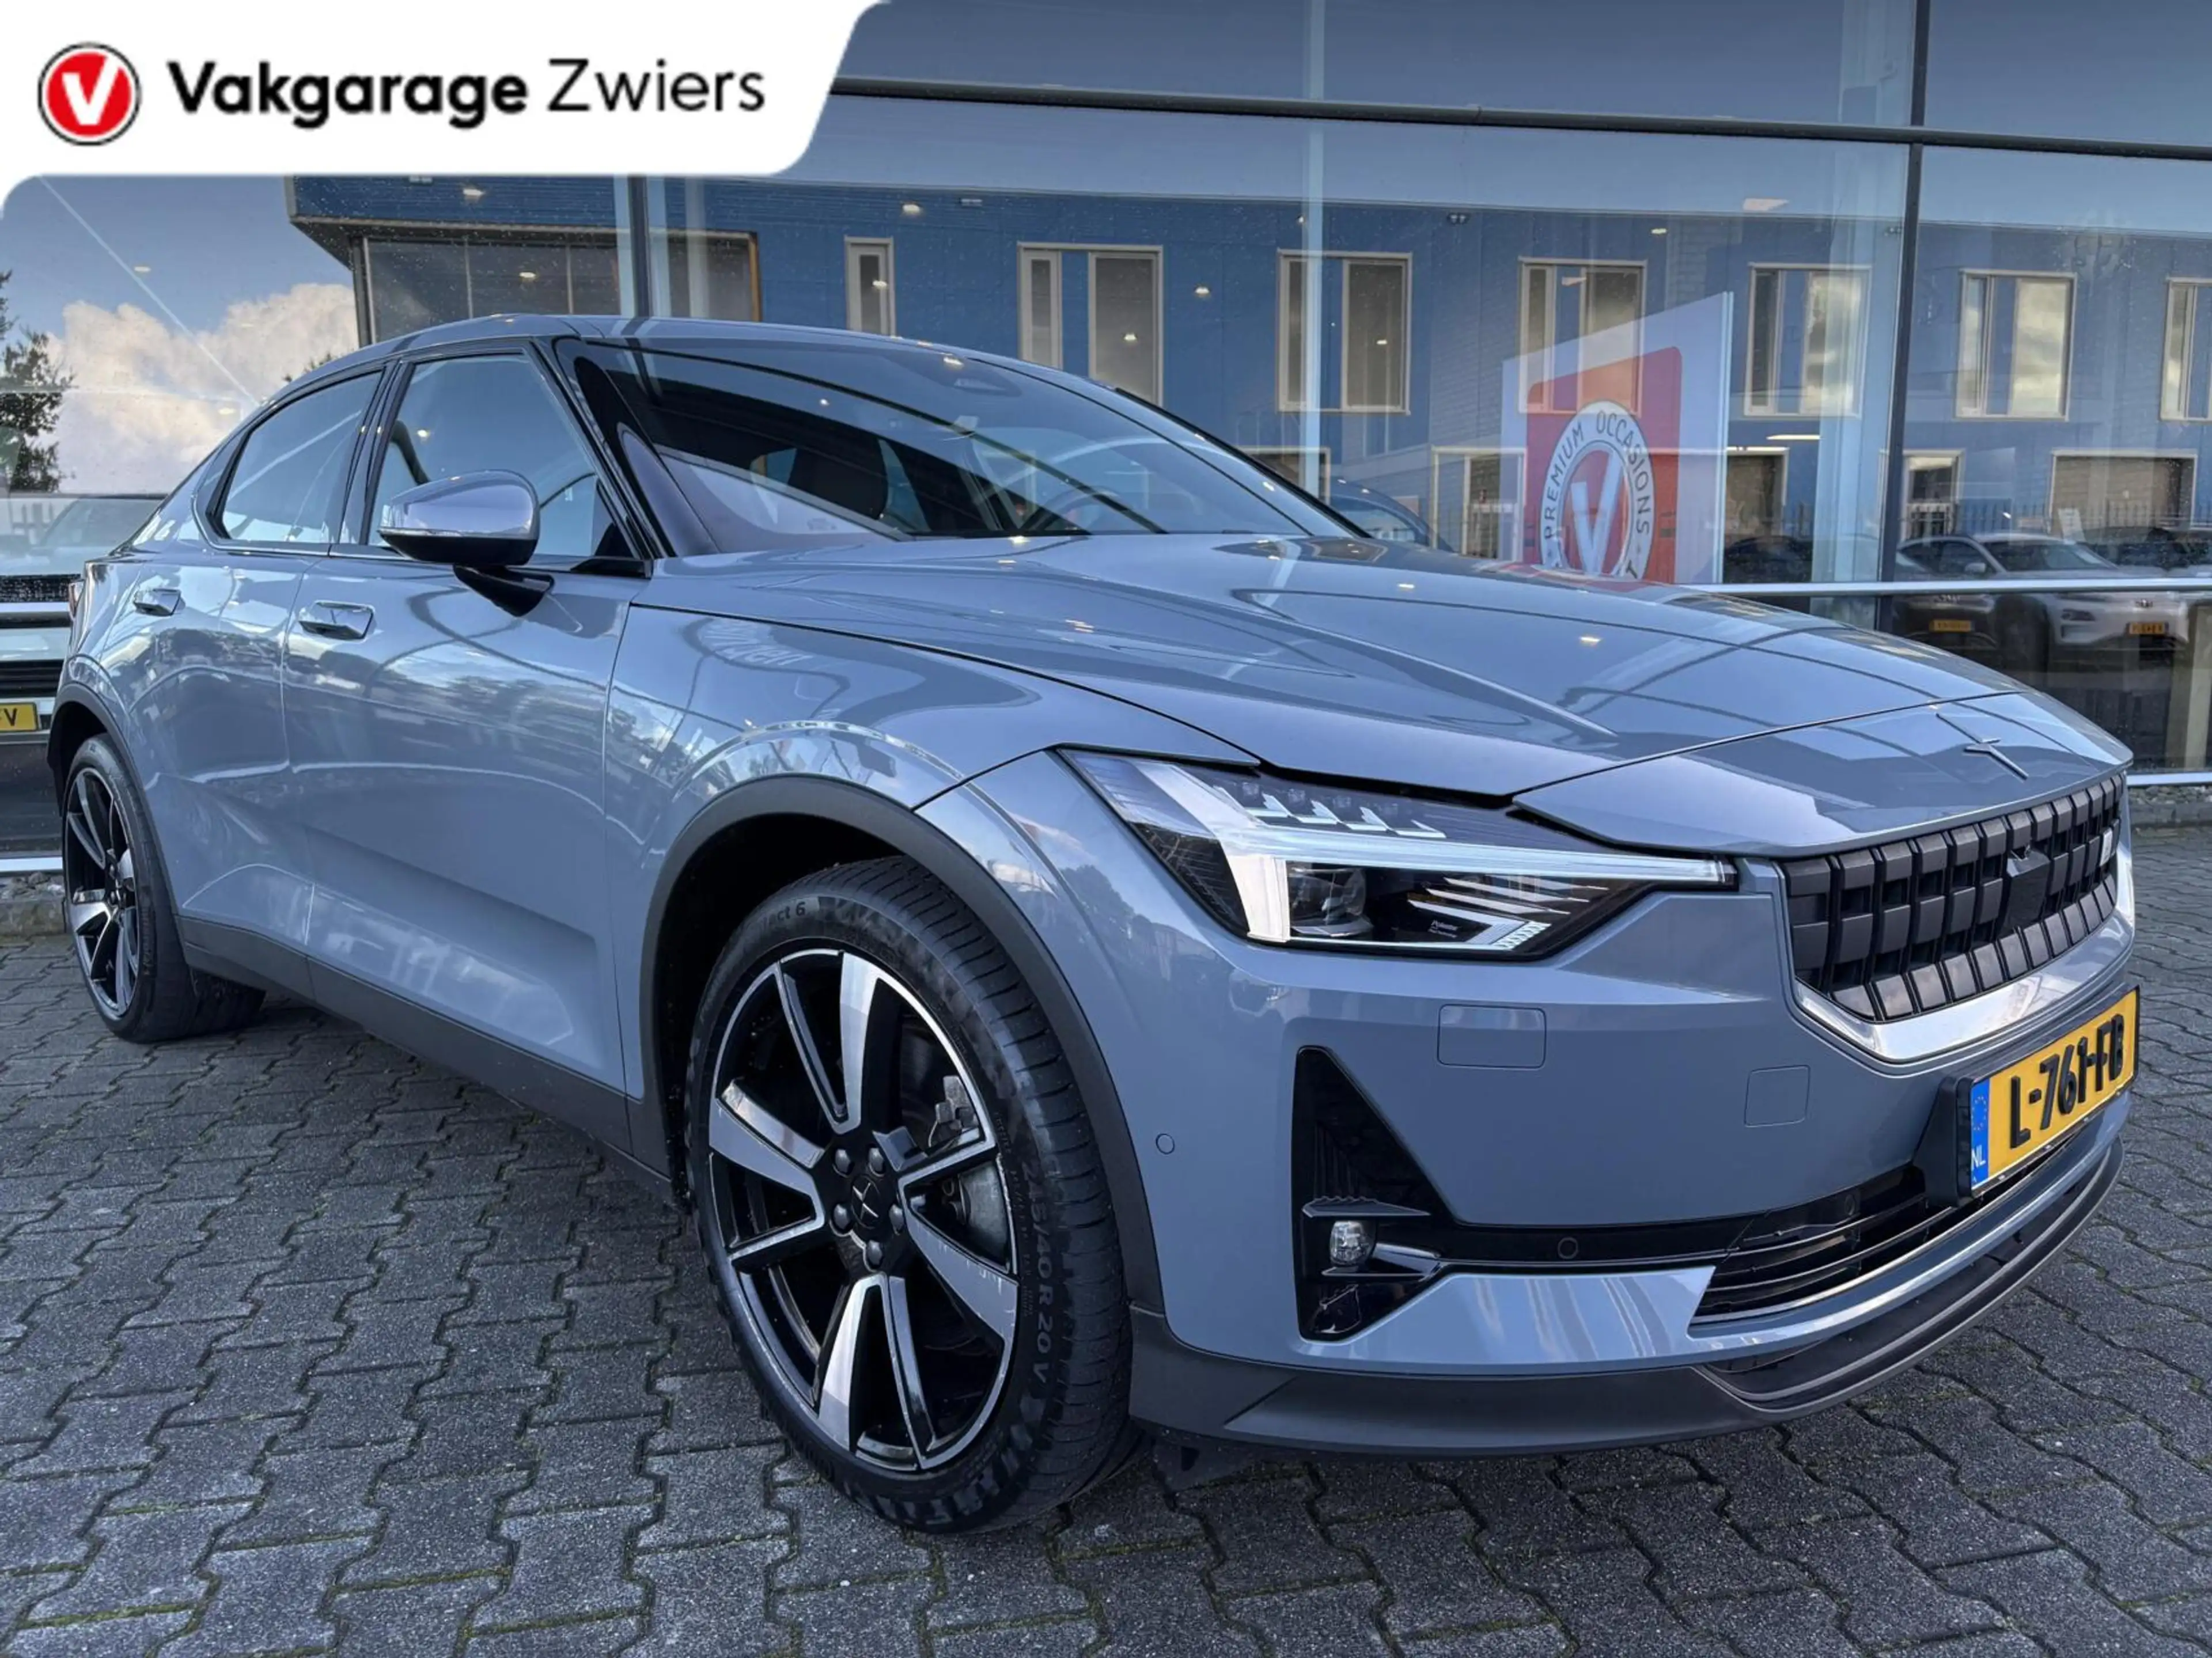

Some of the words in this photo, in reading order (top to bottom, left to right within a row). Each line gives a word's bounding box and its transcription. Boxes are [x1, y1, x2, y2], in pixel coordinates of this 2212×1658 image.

[1544, 422, 1585, 540] PREMIUM
[1596, 411, 1651, 534] OCCASIONS
[0, 710, 17, 727] V
[1971, 1144, 1987, 1171] NL
